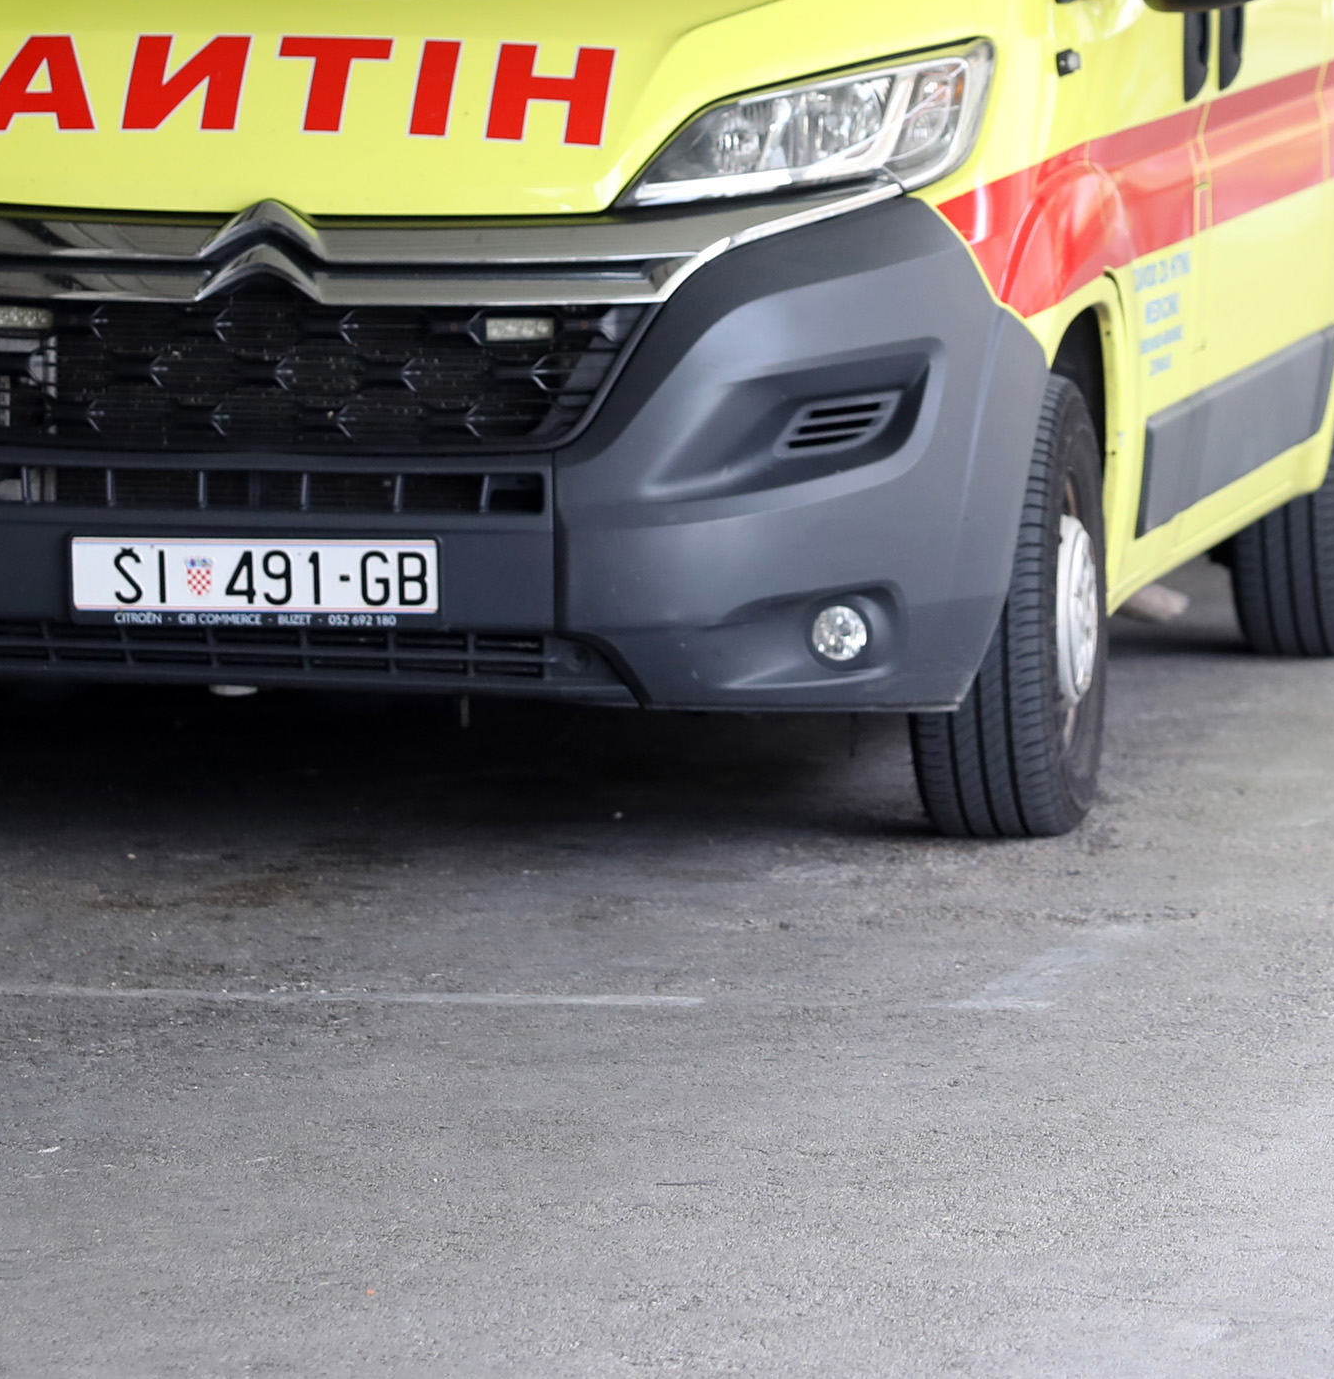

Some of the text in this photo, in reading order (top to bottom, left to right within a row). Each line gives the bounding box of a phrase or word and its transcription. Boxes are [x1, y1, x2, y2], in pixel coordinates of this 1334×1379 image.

[113, 547, 429, 607] ŠI 491-GB
[114, 611, 163, 625] CITROËN
[198, 613, 263, 626] COMMERCE
[327, 614, 350, 627] 052
[375, 614, 397, 627] 180
